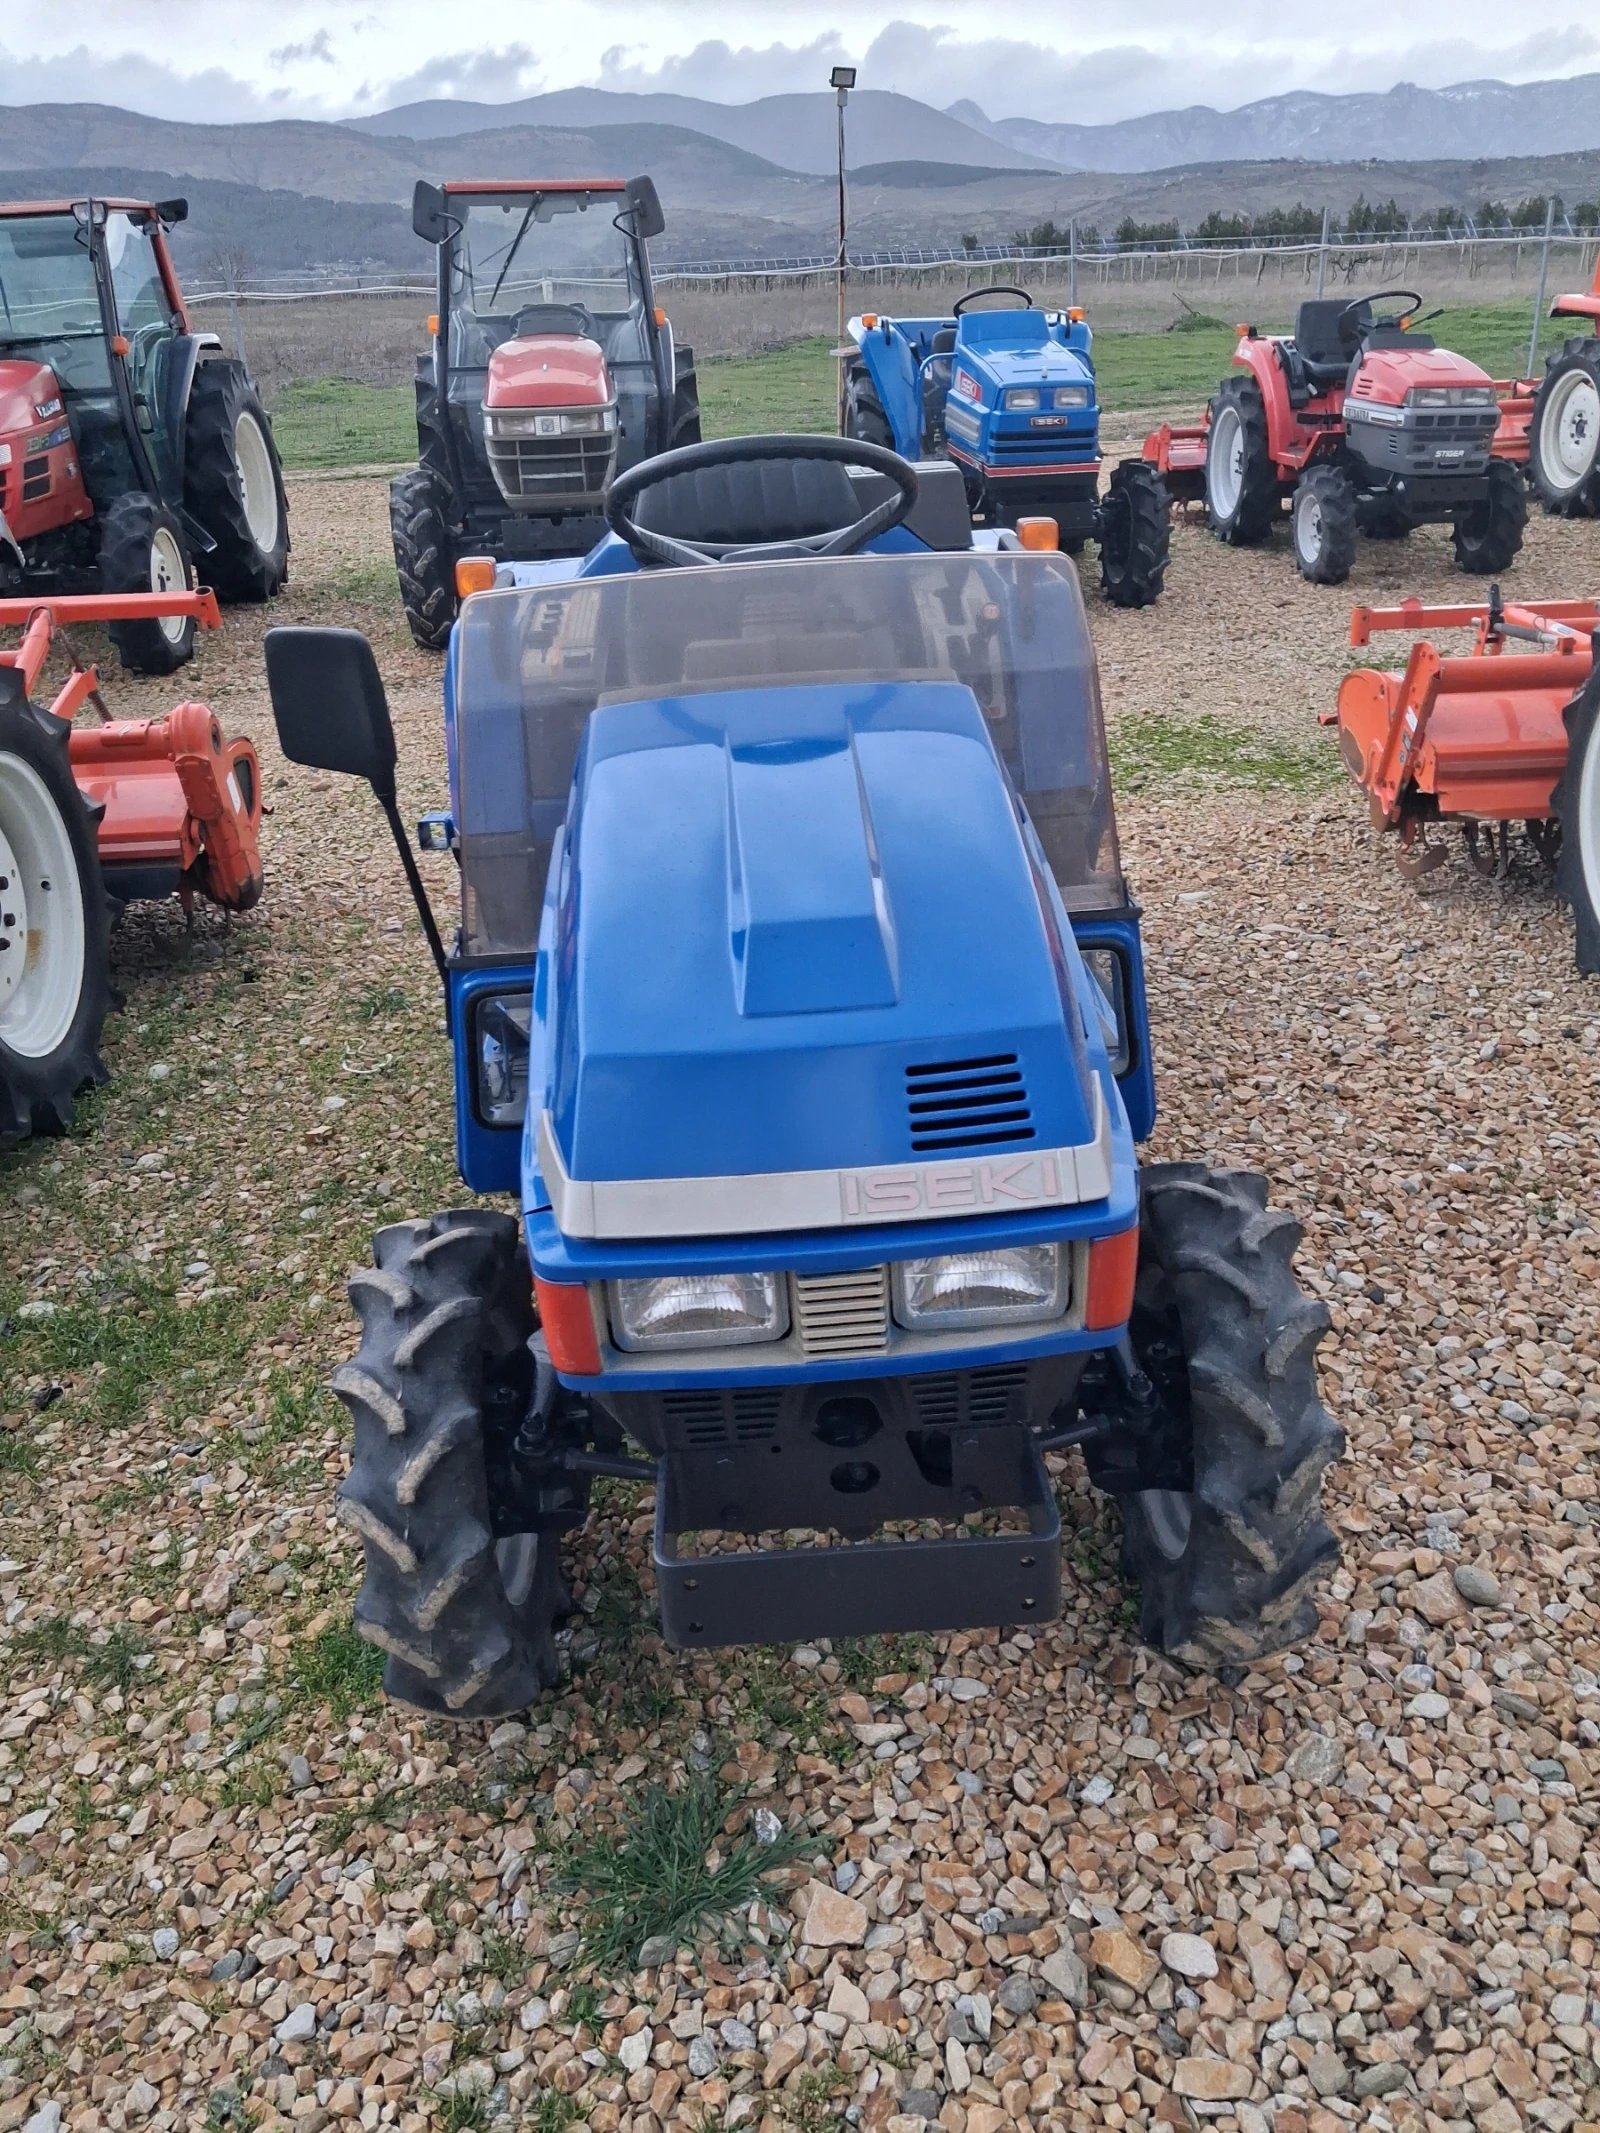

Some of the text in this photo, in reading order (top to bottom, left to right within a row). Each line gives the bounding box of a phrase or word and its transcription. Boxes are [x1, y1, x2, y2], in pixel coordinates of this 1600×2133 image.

[1034, 417, 1065, 426] ISEKI
[1434, 449, 1466, 458] STIGER
[844, 1157, 1058, 1216] ISEKI
